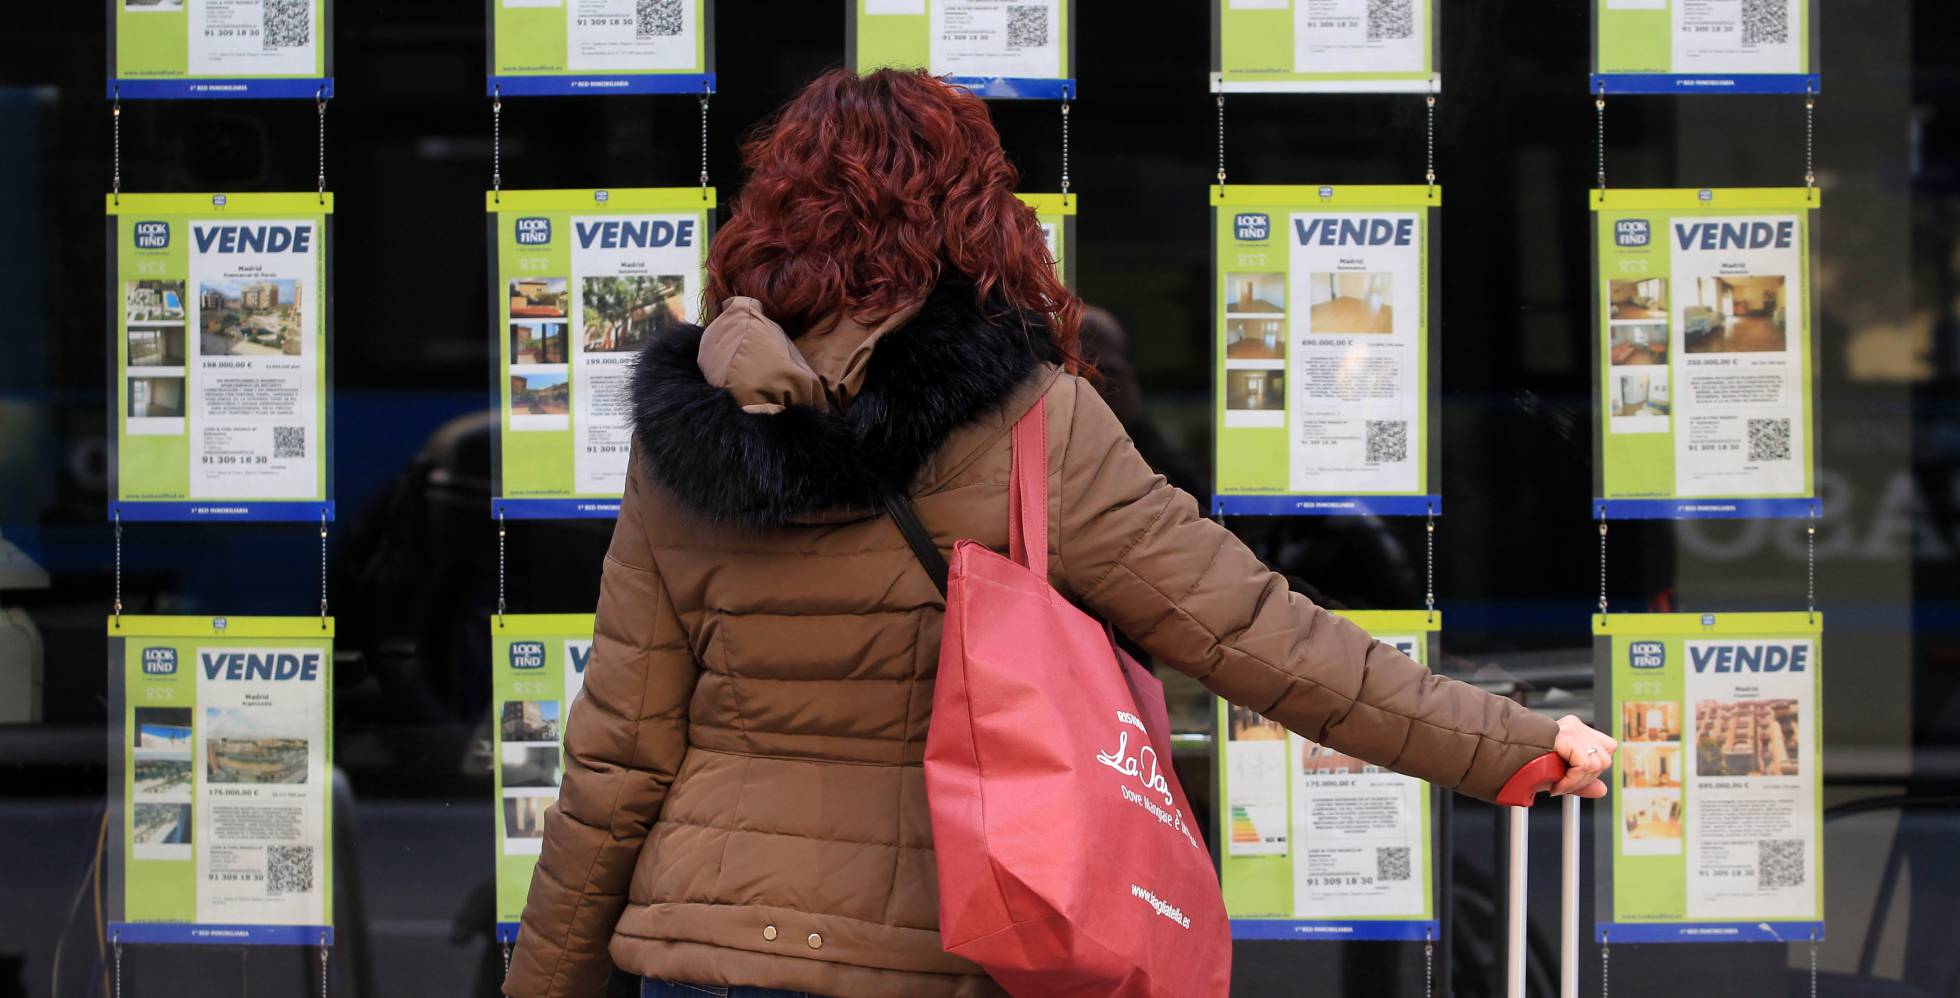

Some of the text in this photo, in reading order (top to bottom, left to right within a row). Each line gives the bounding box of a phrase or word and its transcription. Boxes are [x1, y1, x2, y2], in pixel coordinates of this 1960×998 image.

[204, 29, 260, 37] 91 309 18 30
[519, 220, 547, 230] LOOK
[1237, 215, 1267, 226] LOOK
[138, 223, 166, 234] LOOK
[1294, 218, 1414, 246] VENDE
[1618, 221, 1647, 232] LOOK
[521, 233, 547, 243] FIND
[575, 220, 695, 249] VENDE
[1239, 228, 1265, 238] FIND
[1674, 221, 1794, 250] VENDE
[139, 237, 165, 247] FIND
[193, 226, 312, 253] VENDE
[1620, 235, 1646, 245] FIND
[202, 456, 268, 464] 91 309 18 30
[512, 643, 542, 655] LOOK
[1633, 643, 1662, 654] LOOK
[145, 649, 174, 660] LOOK
[1689, 645, 1808, 673] VENDE
[514, 656, 541, 667] FIND
[1634, 656, 1661, 666] FIND
[147, 662, 173, 673] FIND
[201, 653, 320, 681] VENDE
[1096, 731, 1138, 776] La
[1121, 784, 1143, 807] Dove
[1307, 877, 1373, 886] 91 309 18 30
